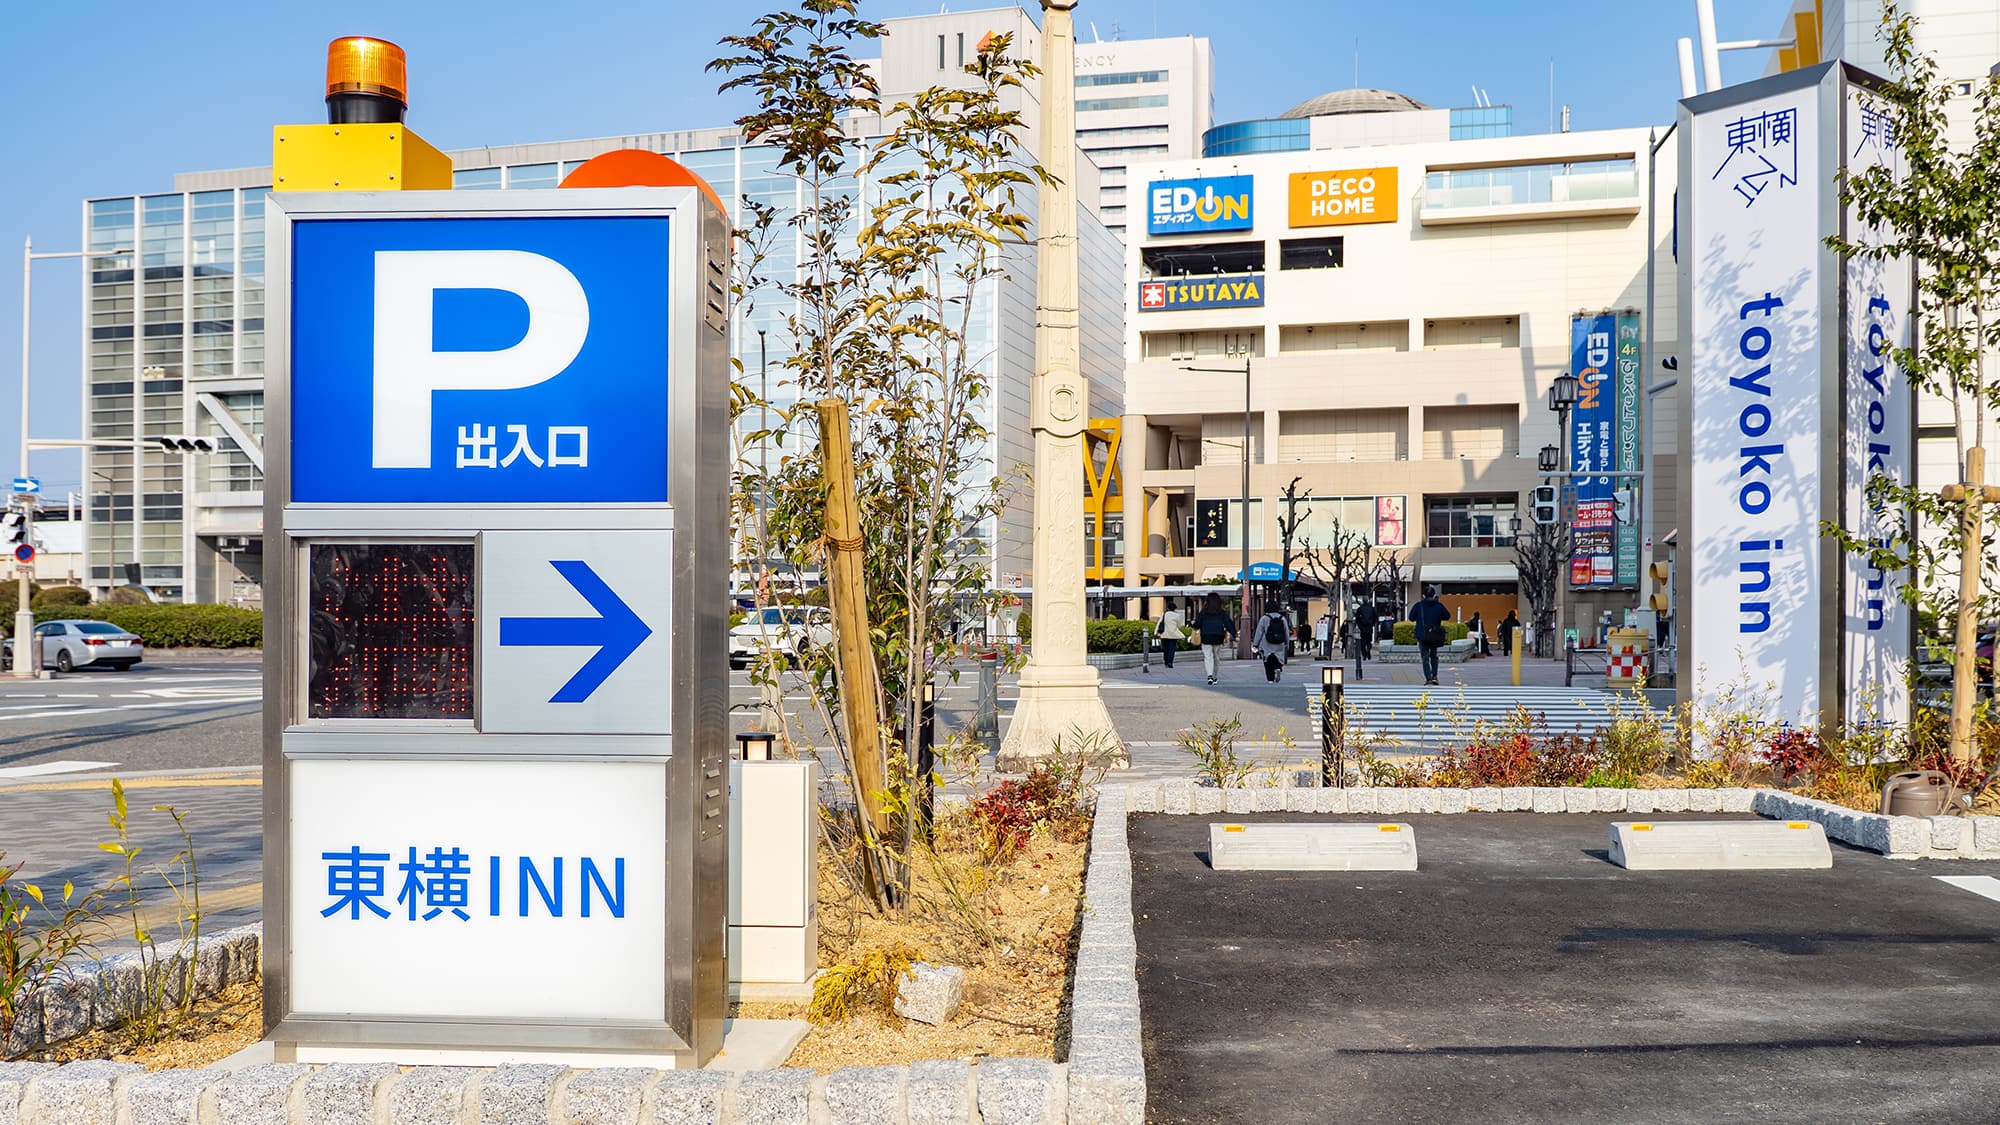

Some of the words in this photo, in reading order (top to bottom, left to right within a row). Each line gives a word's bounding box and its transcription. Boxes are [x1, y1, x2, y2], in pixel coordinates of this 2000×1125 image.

[1152, 185, 1249, 222] EDION
[1311, 177, 1376, 197] DECO
[1153, 213, 1194, 225] エディオン
[1311, 197, 1375, 217] HOME
[1167, 282, 1260, 304] TSUTAYA
[372, 250, 590, 469] P
[1621, 343, 1637, 356] 4F
[1729, 292, 1785, 515] toyoko
[456, 423, 589, 469] 出入口
[1739, 539, 1784, 634] inn
[320, 846, 626, 922] 東横INN
